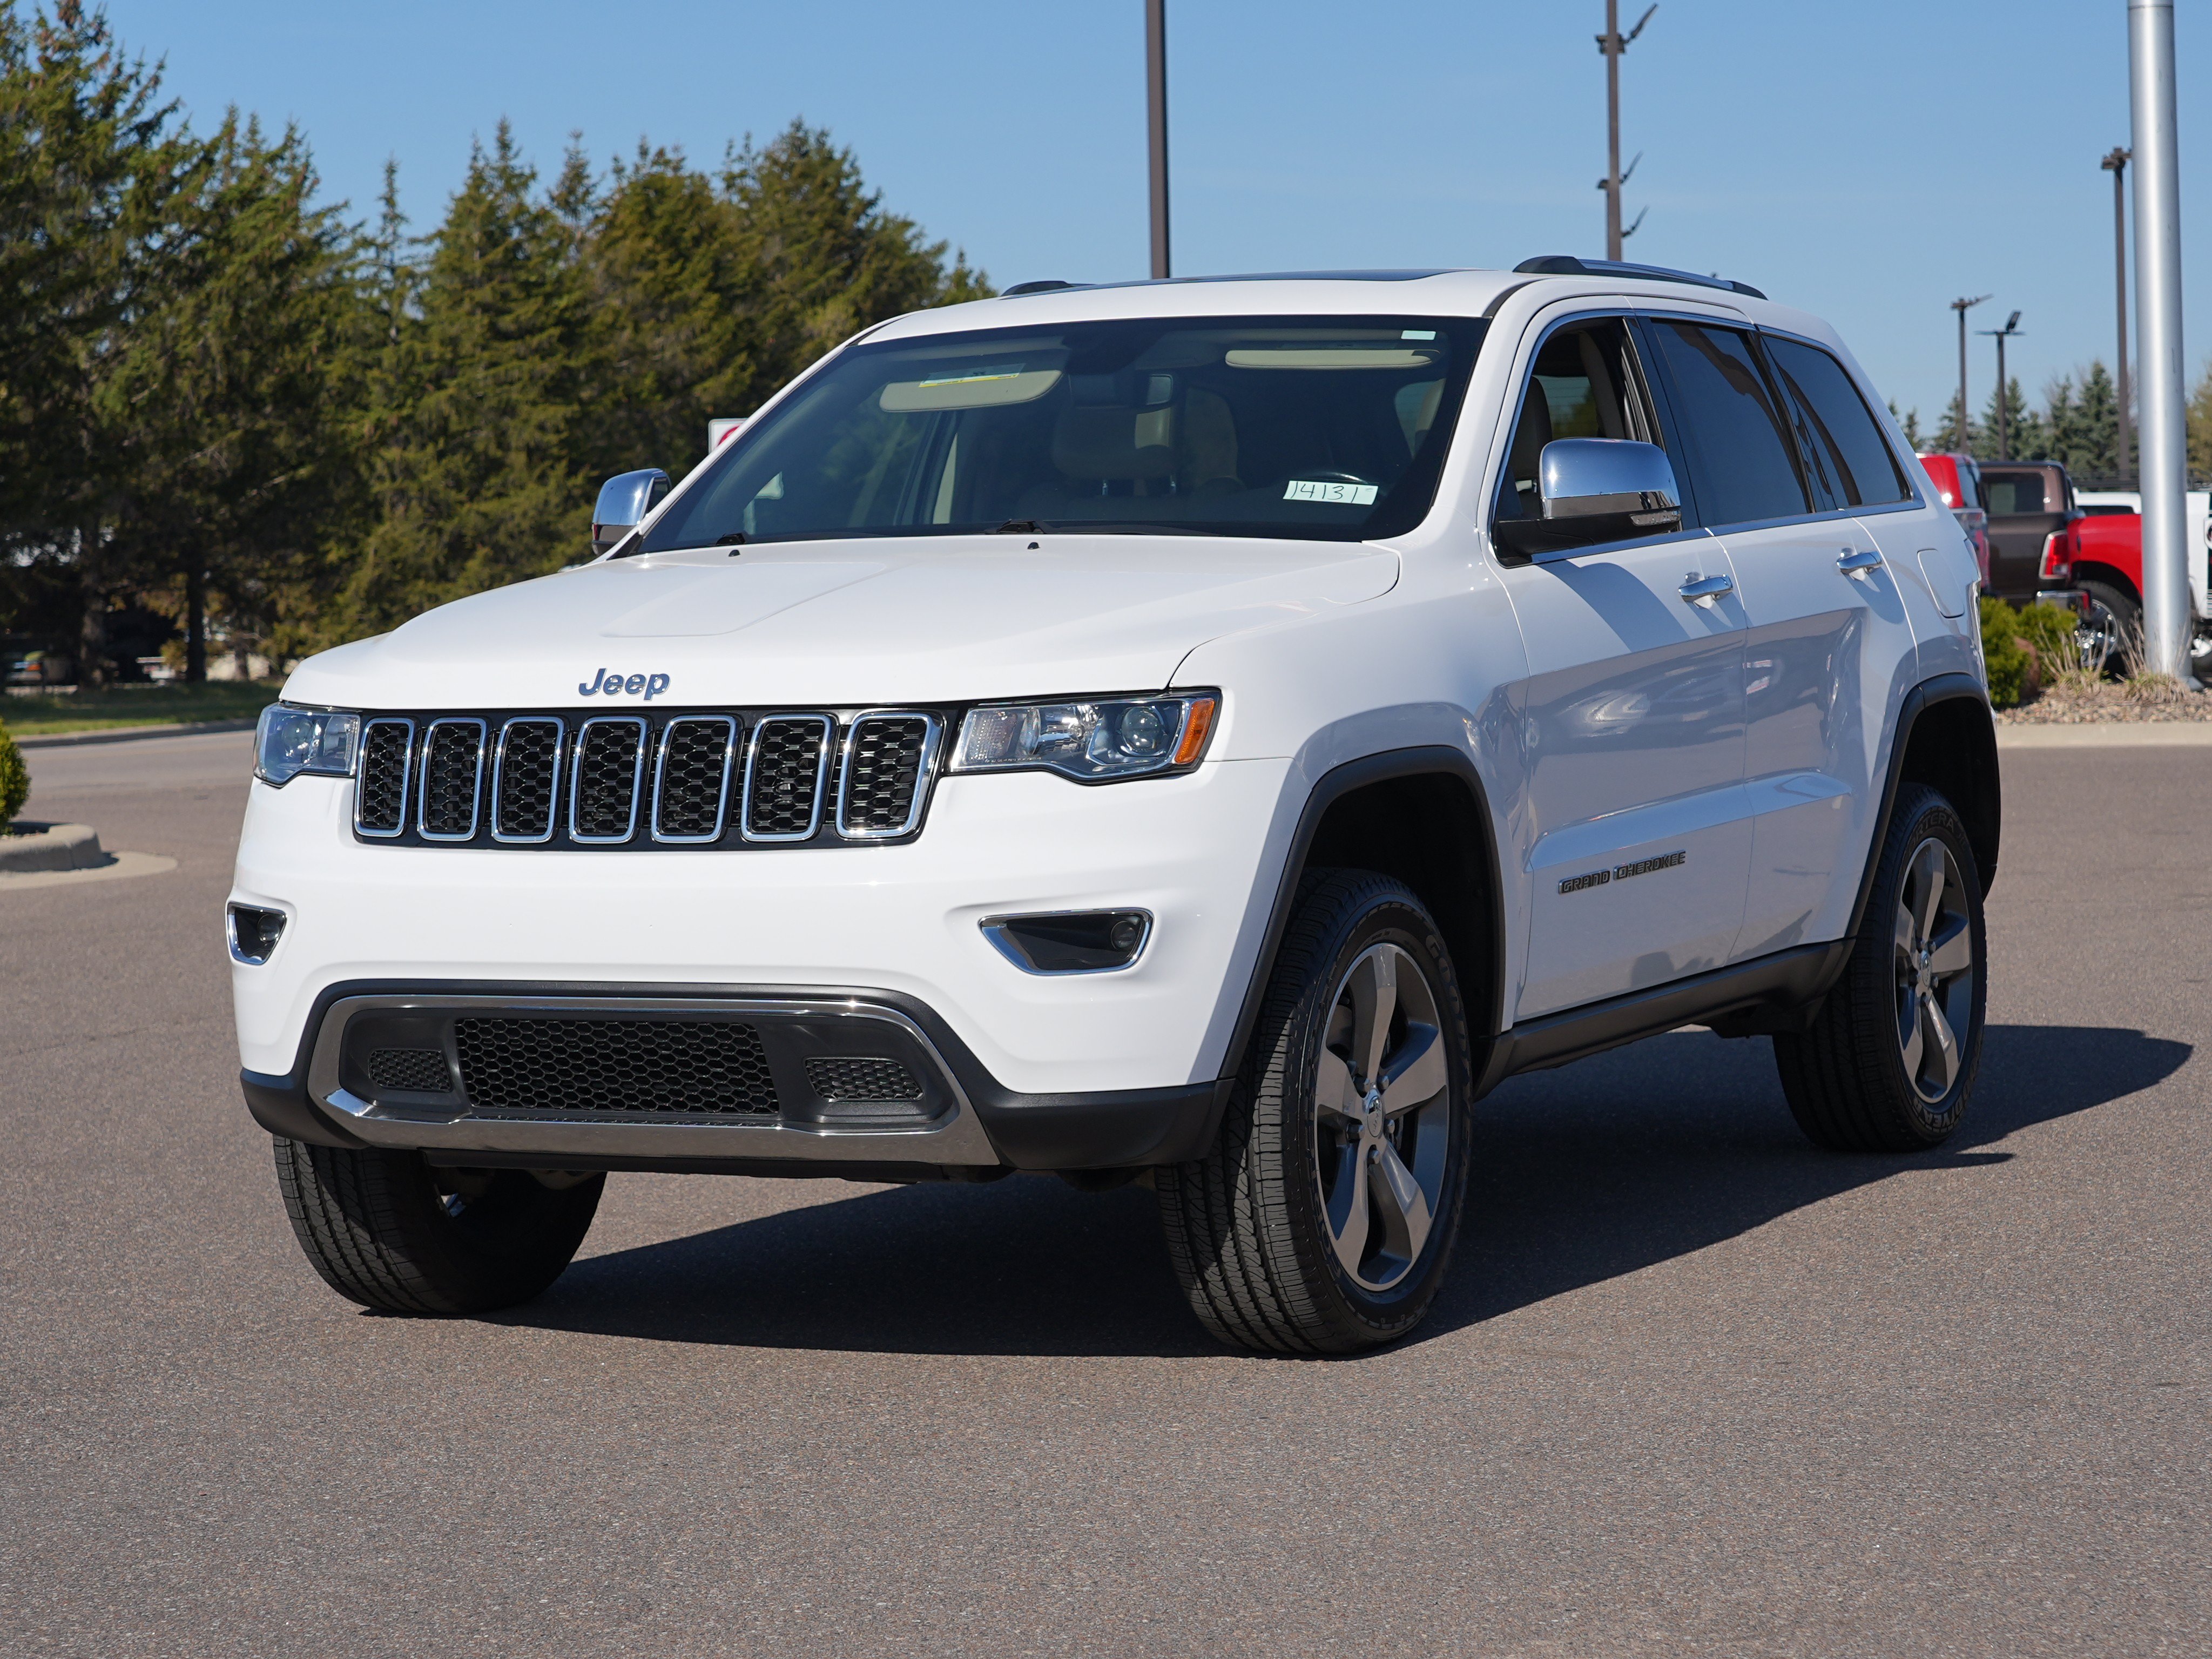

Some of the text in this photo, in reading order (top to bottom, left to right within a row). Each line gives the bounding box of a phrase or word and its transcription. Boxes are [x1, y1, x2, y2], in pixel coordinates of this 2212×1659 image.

[578, 667, 671, 701] Jeep
[1558, 849, 1685, 894] GRAND CHEROKEE
[1425, 934, 1472, 1227] GOODYEAR
